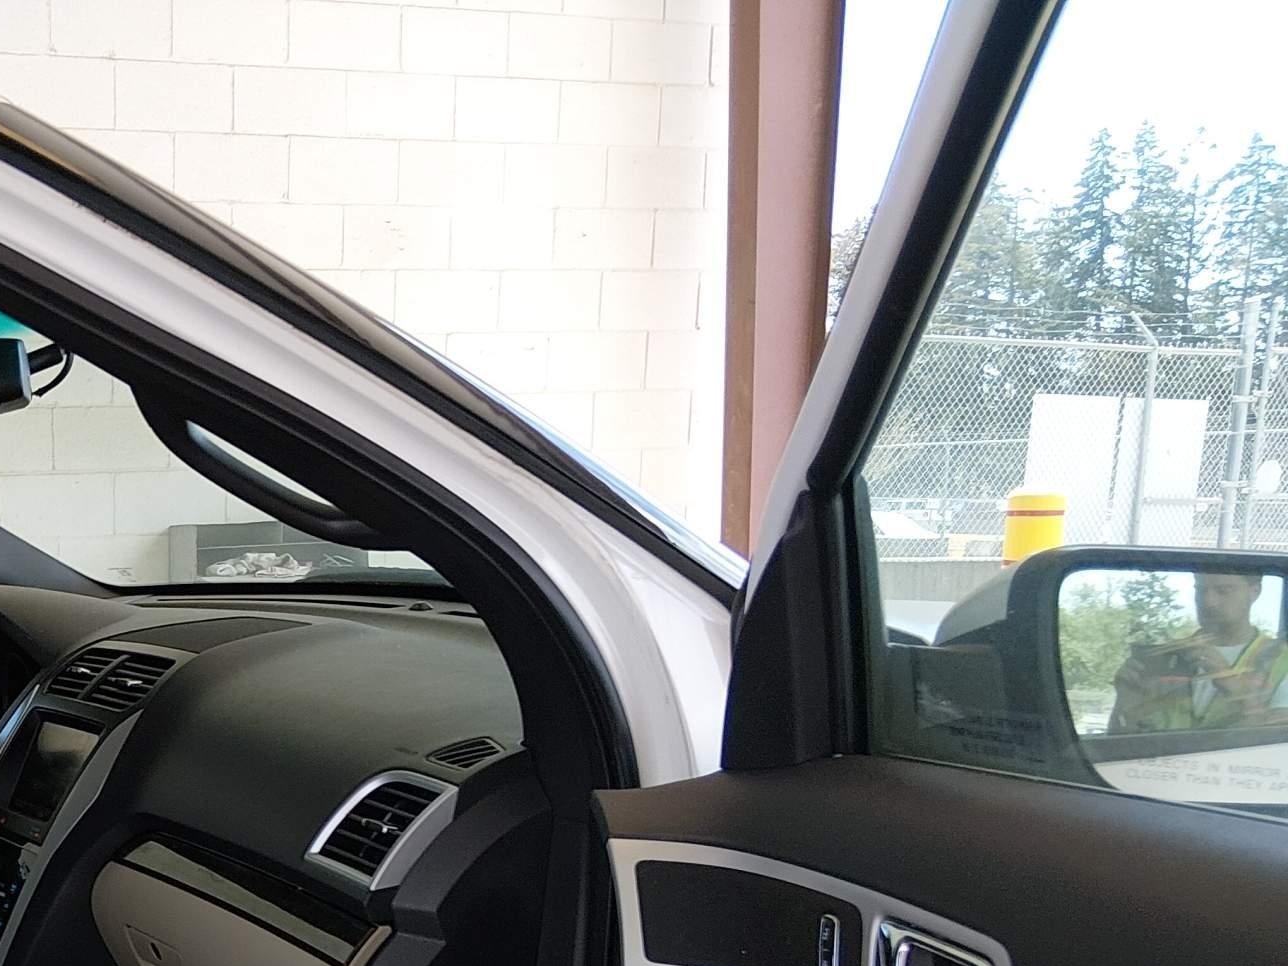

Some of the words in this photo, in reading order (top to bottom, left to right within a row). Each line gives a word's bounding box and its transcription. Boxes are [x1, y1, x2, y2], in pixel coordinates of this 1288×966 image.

[1208, 762, 1220, 772] IN
[1228, 764, 1281, 777] MIRROR
[1127, 768, 1178, 781] CLOSER
[1186, 773, 1221, 786] THAN
[1229, 777, 1263, 790] THEY
